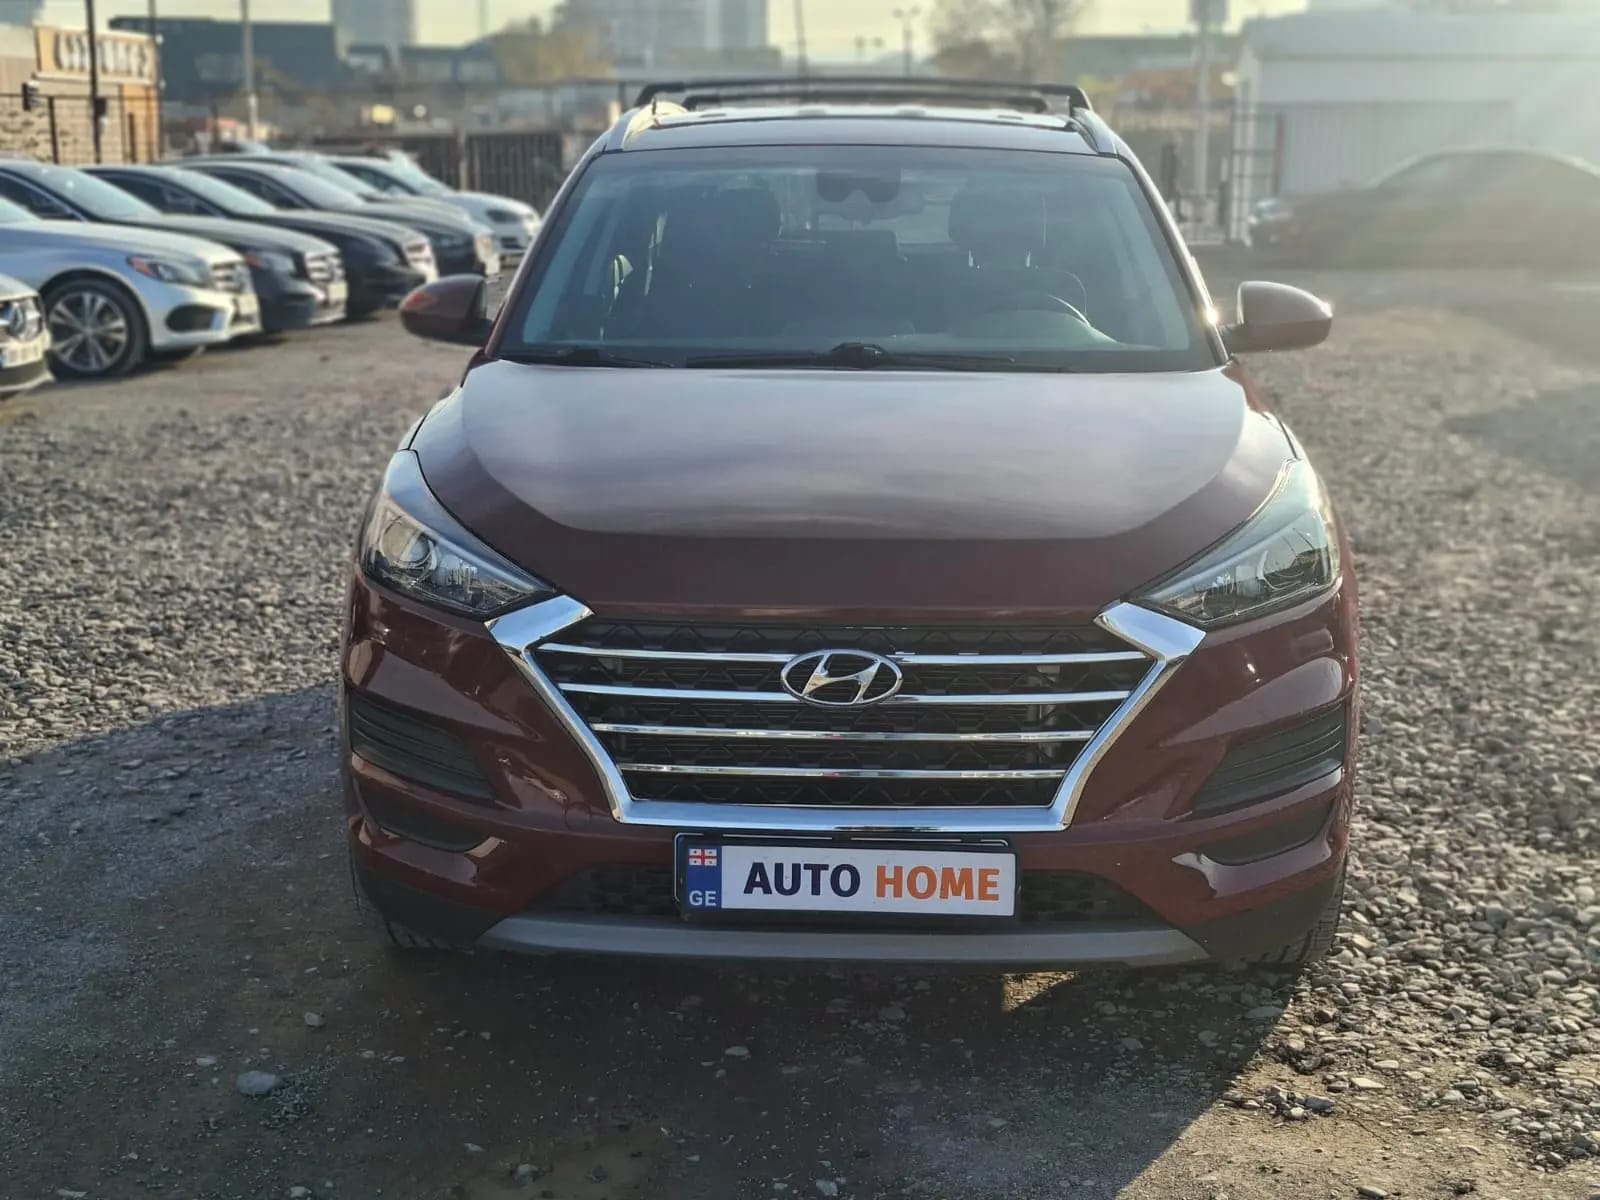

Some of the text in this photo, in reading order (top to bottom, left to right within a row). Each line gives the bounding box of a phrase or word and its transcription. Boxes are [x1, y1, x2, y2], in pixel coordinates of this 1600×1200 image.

[743, 862, 1000, 901] AUTO HOME
[689, 890, 717, 907] GE
